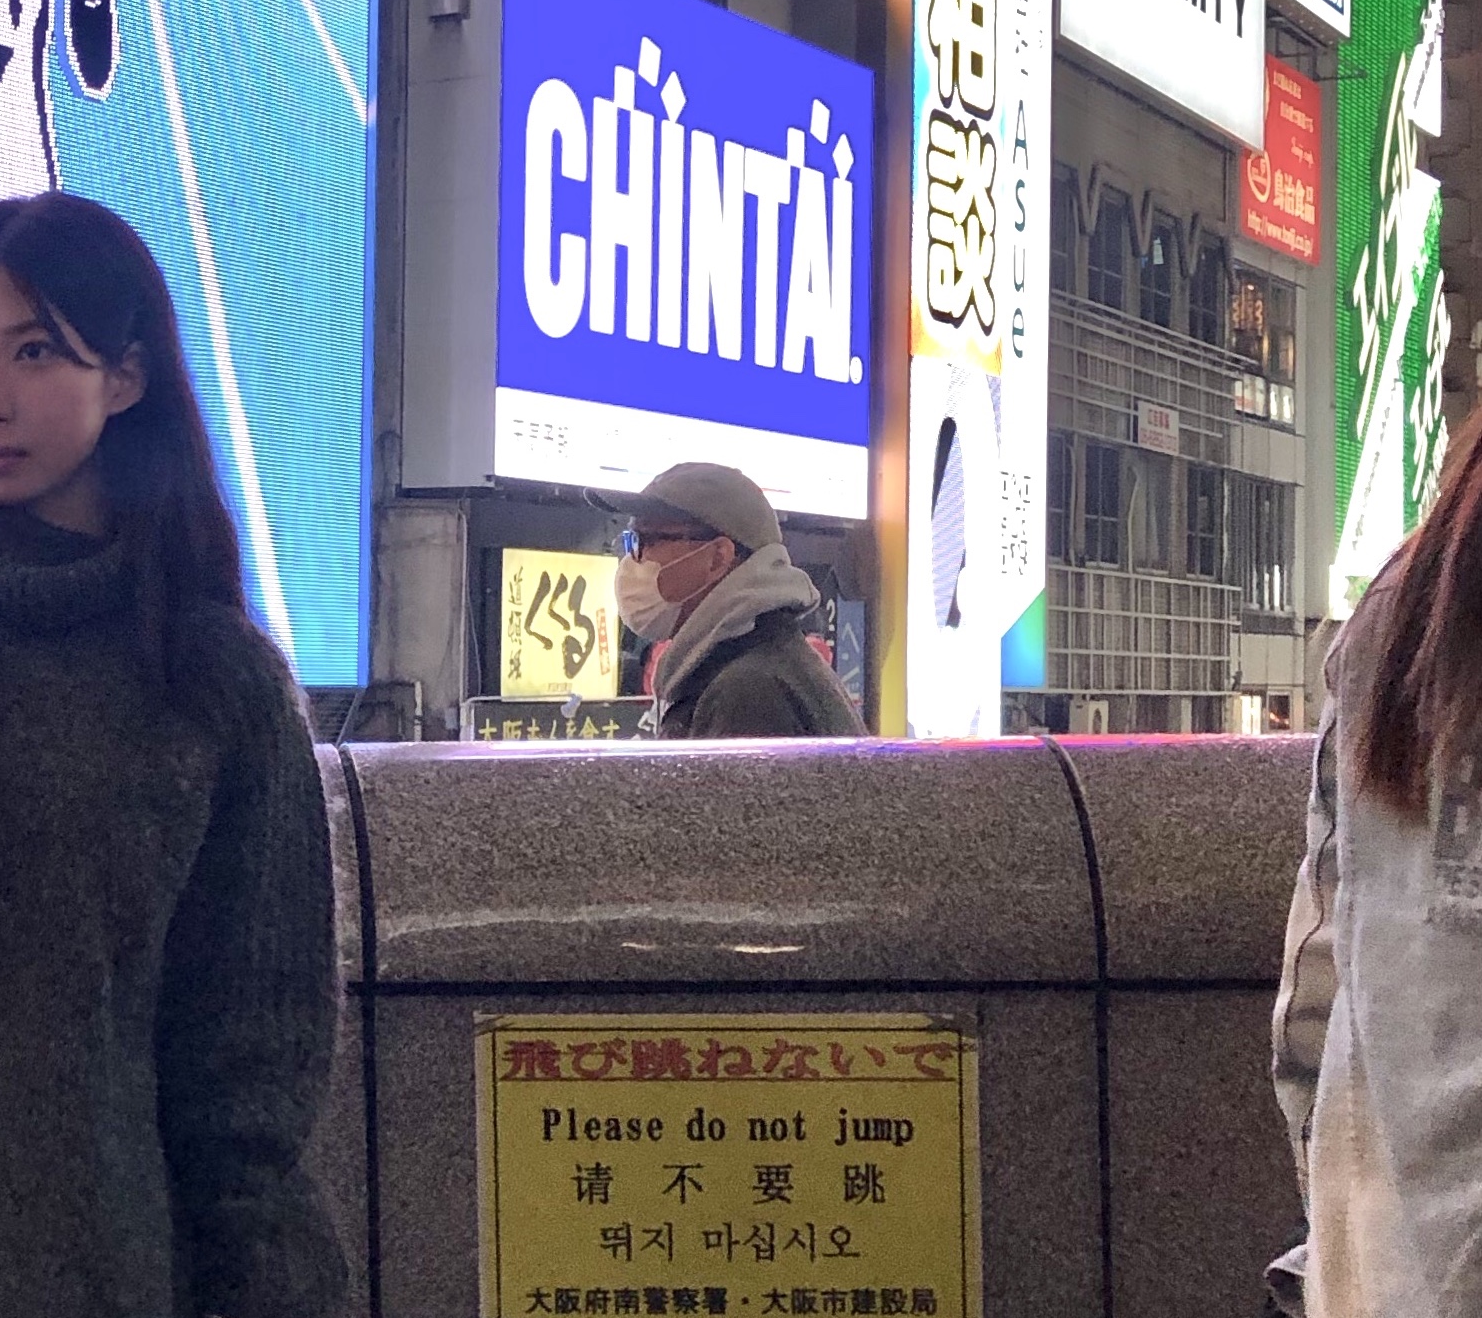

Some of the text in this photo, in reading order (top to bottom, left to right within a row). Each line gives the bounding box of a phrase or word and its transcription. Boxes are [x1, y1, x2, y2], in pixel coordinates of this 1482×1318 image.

[523, 570, 596, 680] くくる
[500, 1037, 959, 1080] 飛び跳ねないで
[541, 1107, 915, 1147] Please do not jump
[599, 1221, 861, 1263] 뛰지 마십시오
